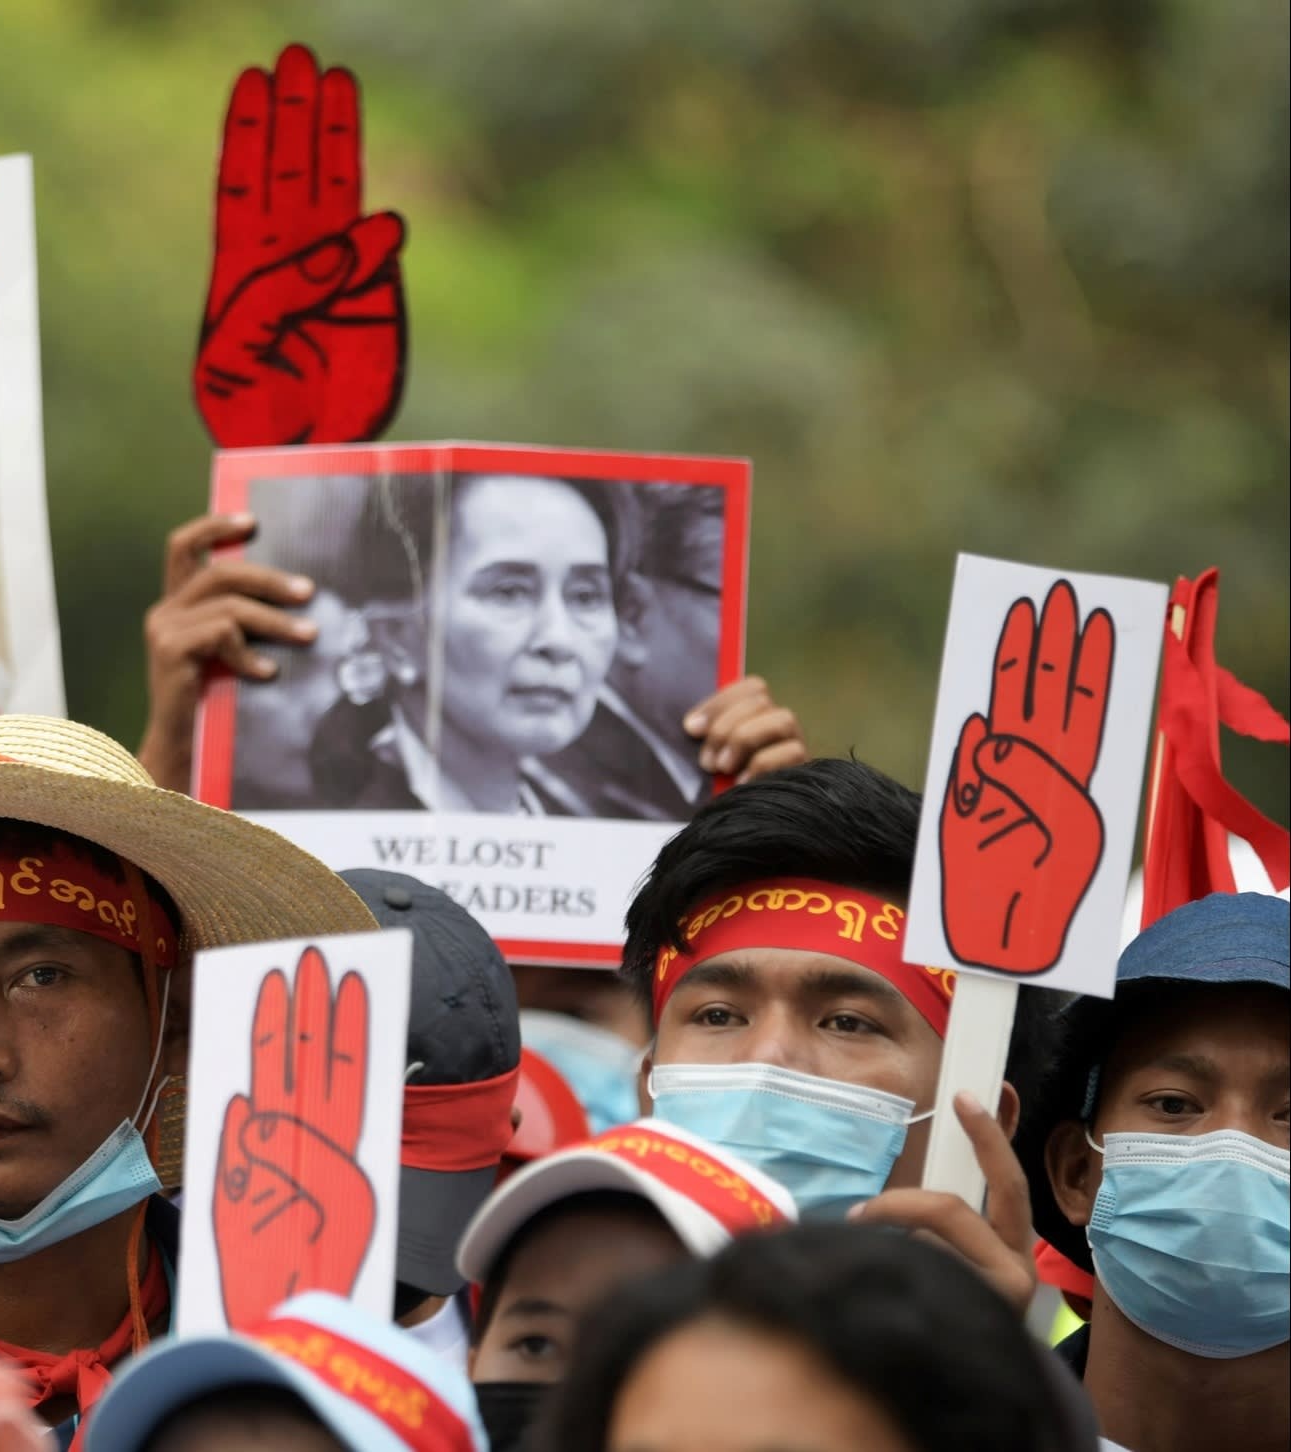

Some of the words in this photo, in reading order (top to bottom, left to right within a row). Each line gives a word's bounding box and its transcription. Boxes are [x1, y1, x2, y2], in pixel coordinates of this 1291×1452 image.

[372, 836, 437, 866] WE
[447, 836, 556, 870] LOST
[440, 880, 597, 918] EADERS
